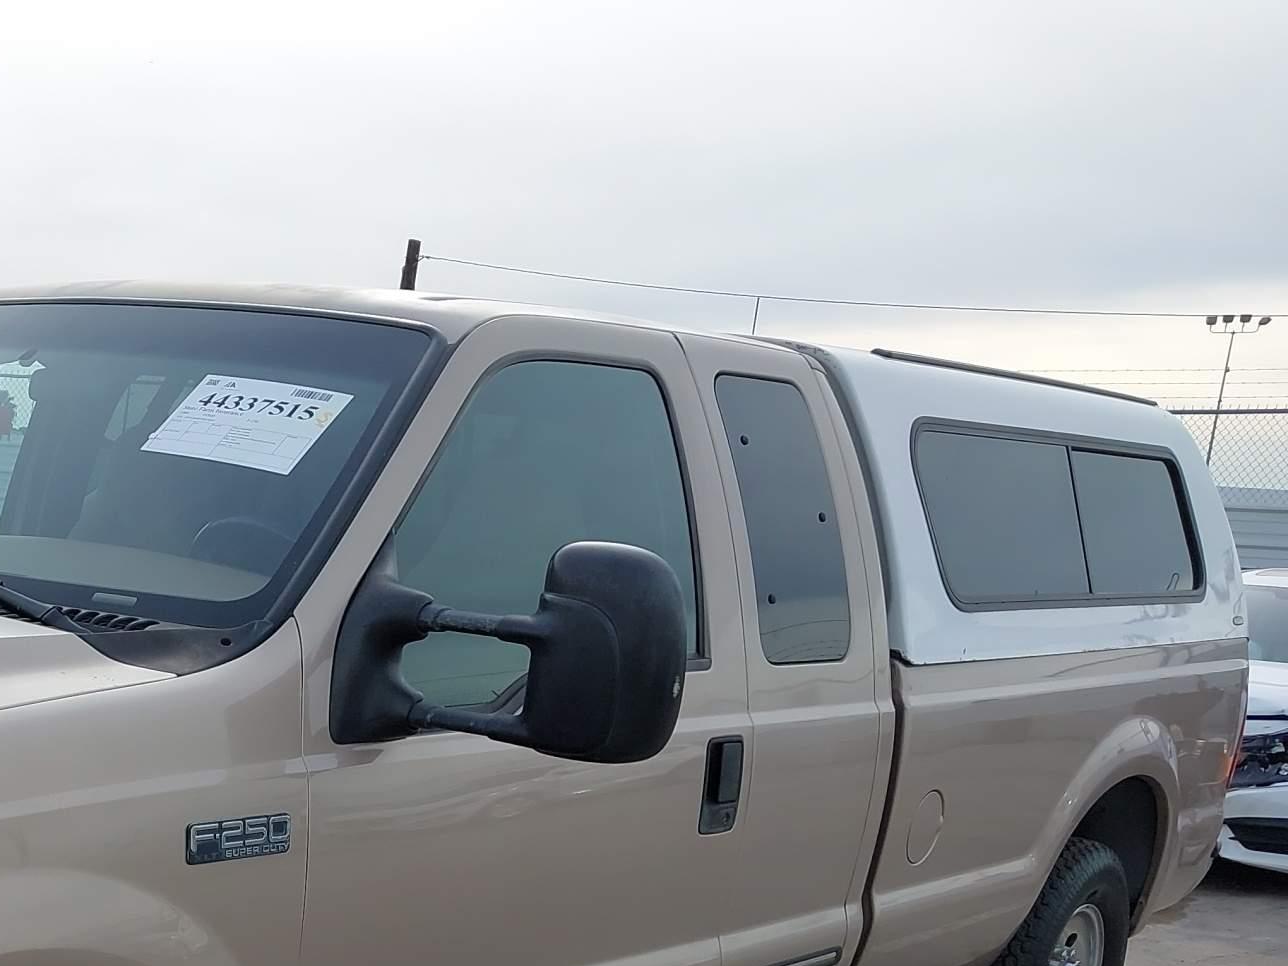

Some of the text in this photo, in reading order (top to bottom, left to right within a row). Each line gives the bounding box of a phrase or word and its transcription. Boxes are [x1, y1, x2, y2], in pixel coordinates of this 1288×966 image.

[198, 392, 320, 421] 44337515
[190, 814, 291, 854] F-250
[225, 842, 290, 858] SUPER DUTY
